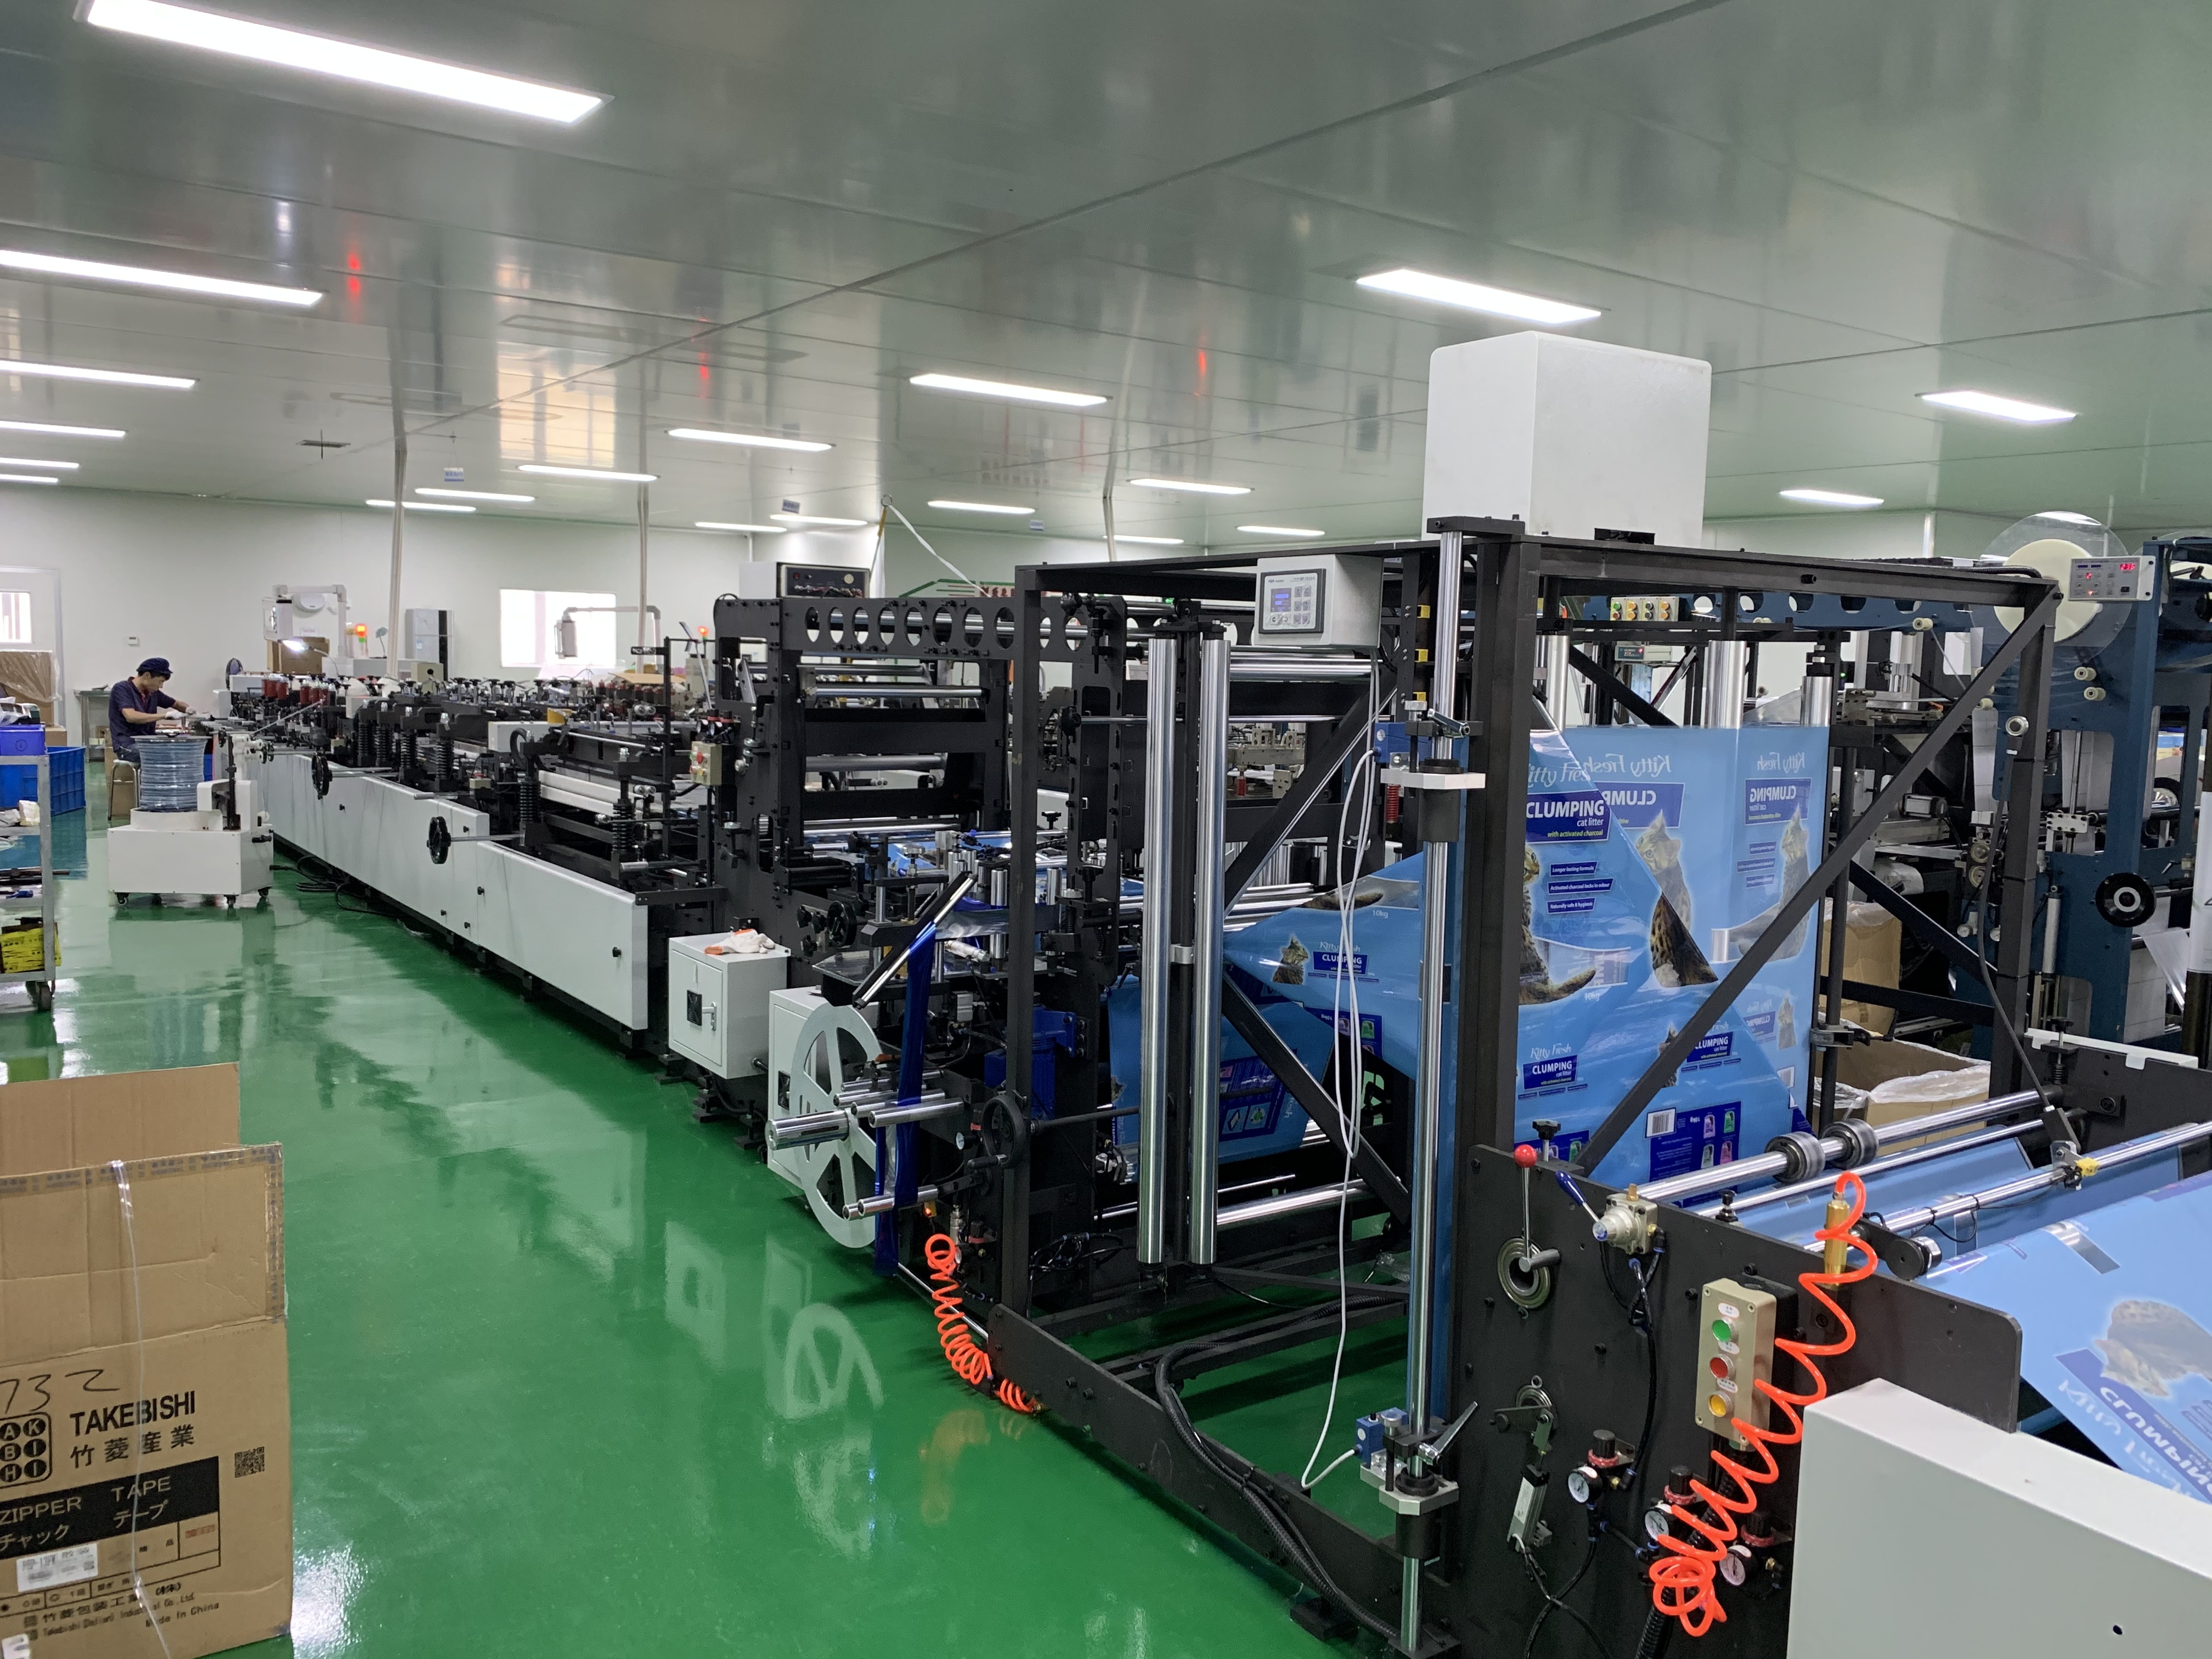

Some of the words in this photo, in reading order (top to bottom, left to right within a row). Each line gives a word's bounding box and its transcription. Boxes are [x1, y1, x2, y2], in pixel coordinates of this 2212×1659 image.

[1560, 760, 1590, 782] Fres
[1526, 800, 1604, 818] CLUMPING
[1577, 819, 1587, 827] cat
[1588, 818, 1604, 826] litter
[1373, 910, 1389, 919] 10kg
[1584, 991, 1600, 1001] 10kg
[1532, 1060, 1572, 1075] CLUMPING
[70, 1391, 195, 1437] TAKEBISHI
[0, 1497, 82, 1525] ZIPPER
[111, 1476, 171, 1502] TAPE
[145, 1615, 172, 1628] Mde
[190, 1601, 219, 1616] China
